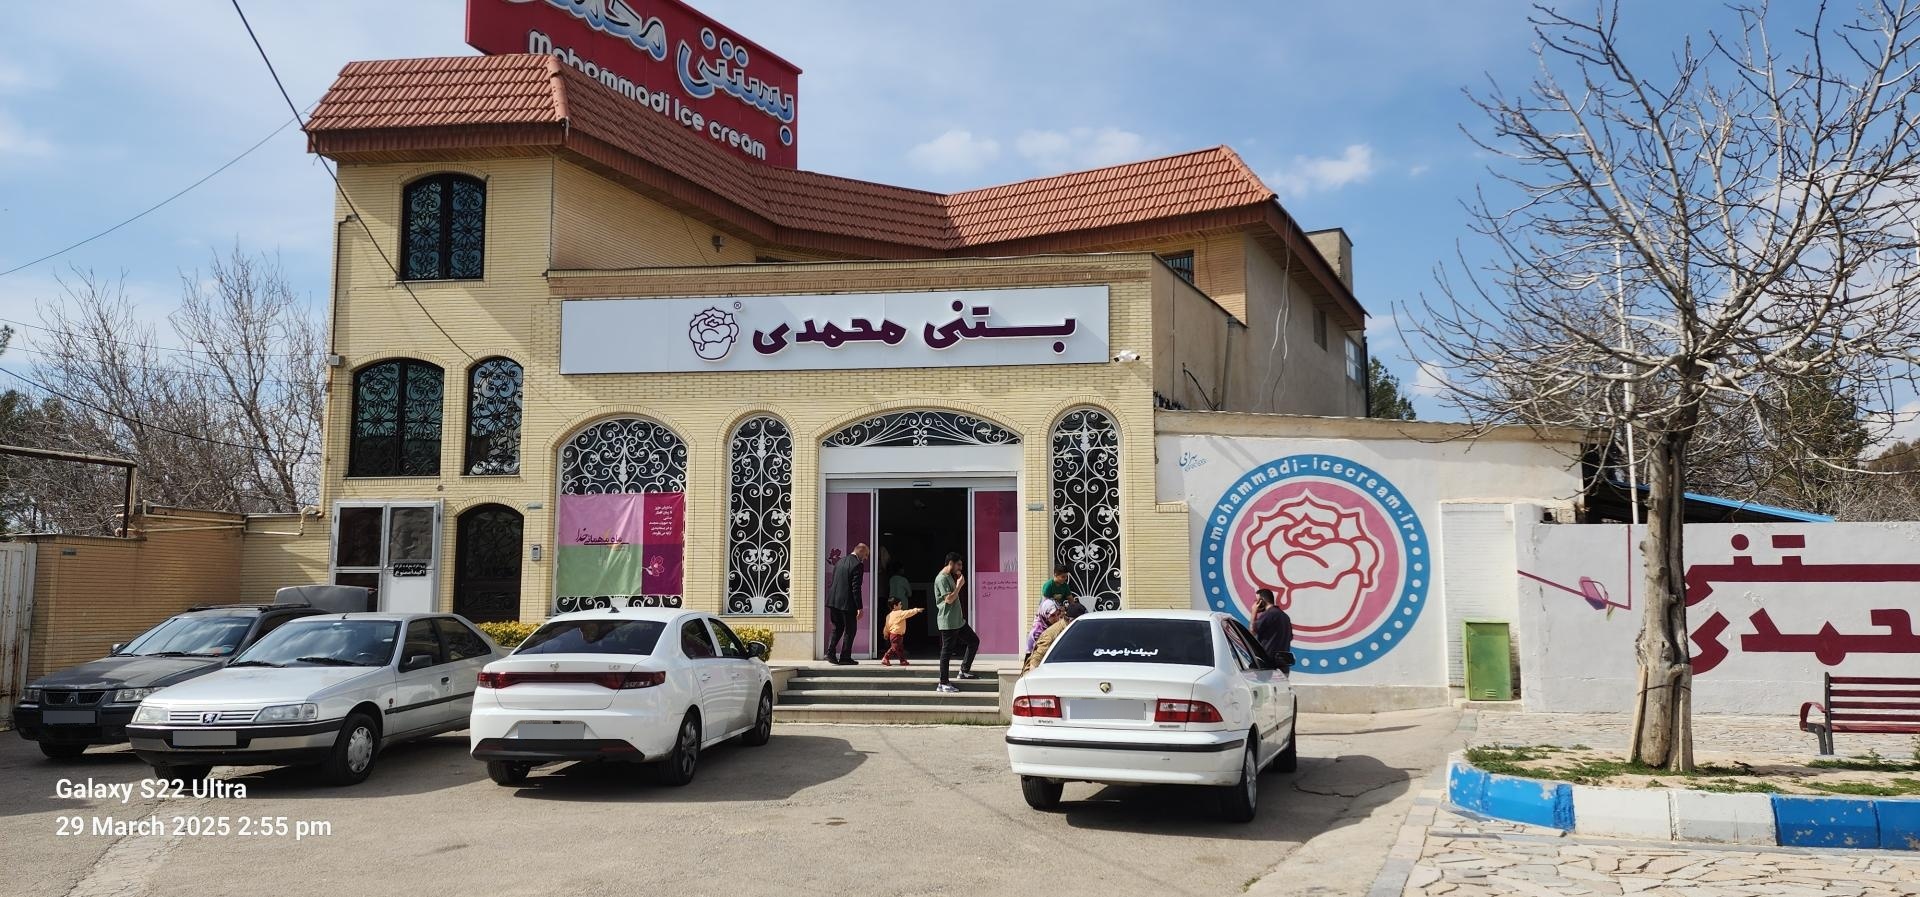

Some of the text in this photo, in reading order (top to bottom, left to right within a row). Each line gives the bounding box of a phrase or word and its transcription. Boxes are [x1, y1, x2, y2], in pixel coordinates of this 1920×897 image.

[677, 27, 794, 146] بستنی
[674, 98, 705, 130] Ice
[708, 121, 766, 160] cream
[753, 318, 907, 355] محمدی
